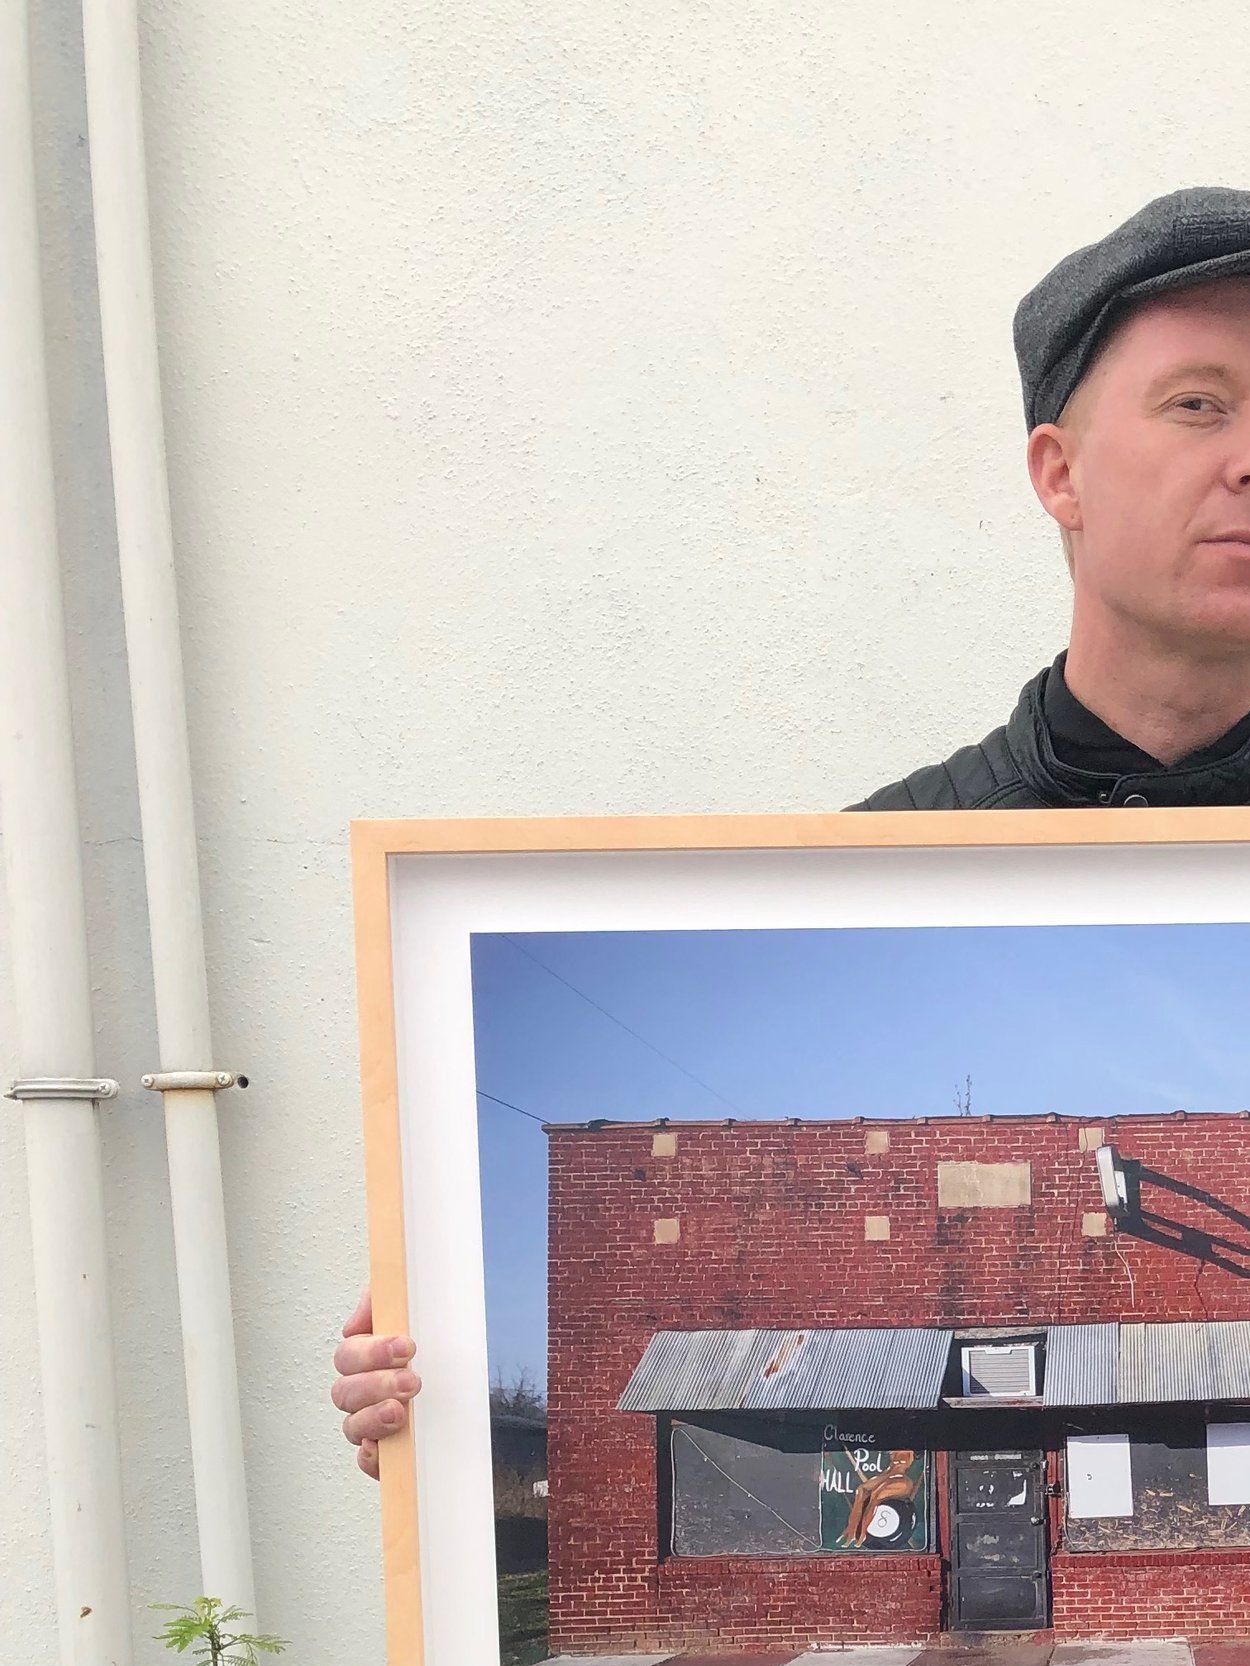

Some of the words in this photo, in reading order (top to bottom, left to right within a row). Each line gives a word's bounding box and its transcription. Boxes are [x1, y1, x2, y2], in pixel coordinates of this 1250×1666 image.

[823, 1424, 876, 1443] Clarence
[854, 1448, 883, 1472] Pool
[820, 1468, 854, 1493] HALL
[877, 1510, 892, 1528] 8
